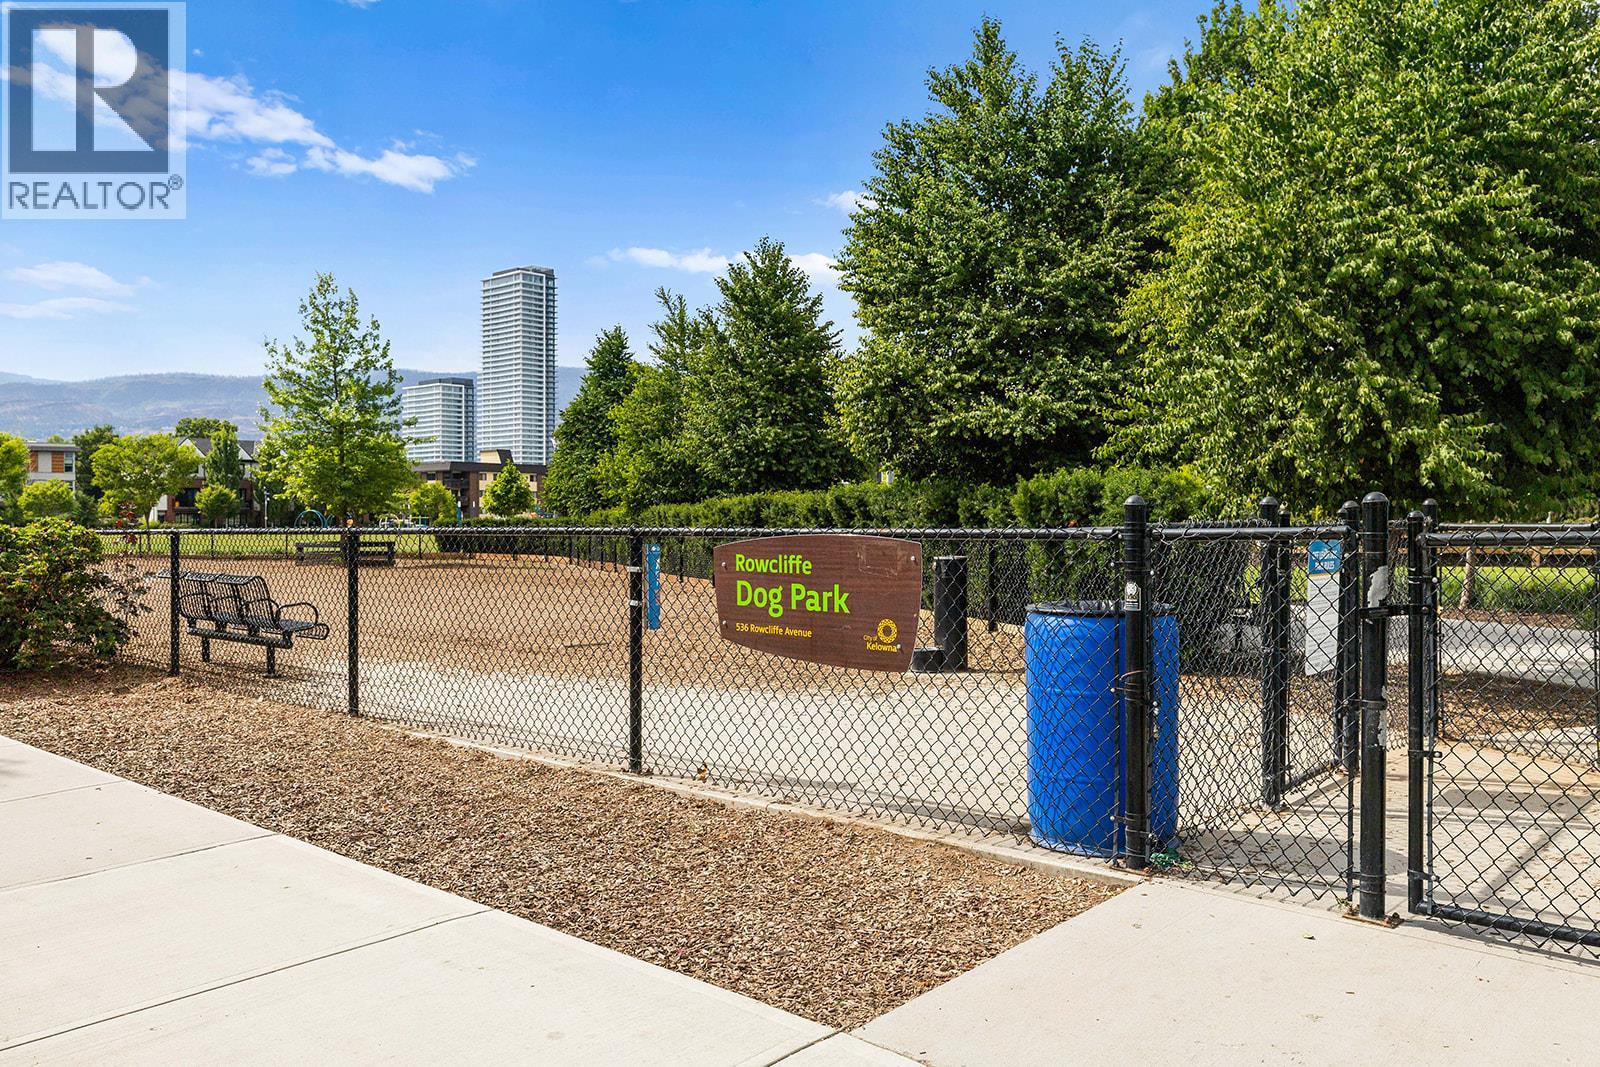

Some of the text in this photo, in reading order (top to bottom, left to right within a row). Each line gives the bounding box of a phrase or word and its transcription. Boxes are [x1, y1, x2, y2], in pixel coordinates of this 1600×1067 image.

[735, 553, 813, 575] Rowcliffe
[736, 580, 850, 618] Dog Park
[735, 622, 813, 638] 536 Rowcliffe Avenue
[866, 641, 898, 653] Kelowna
